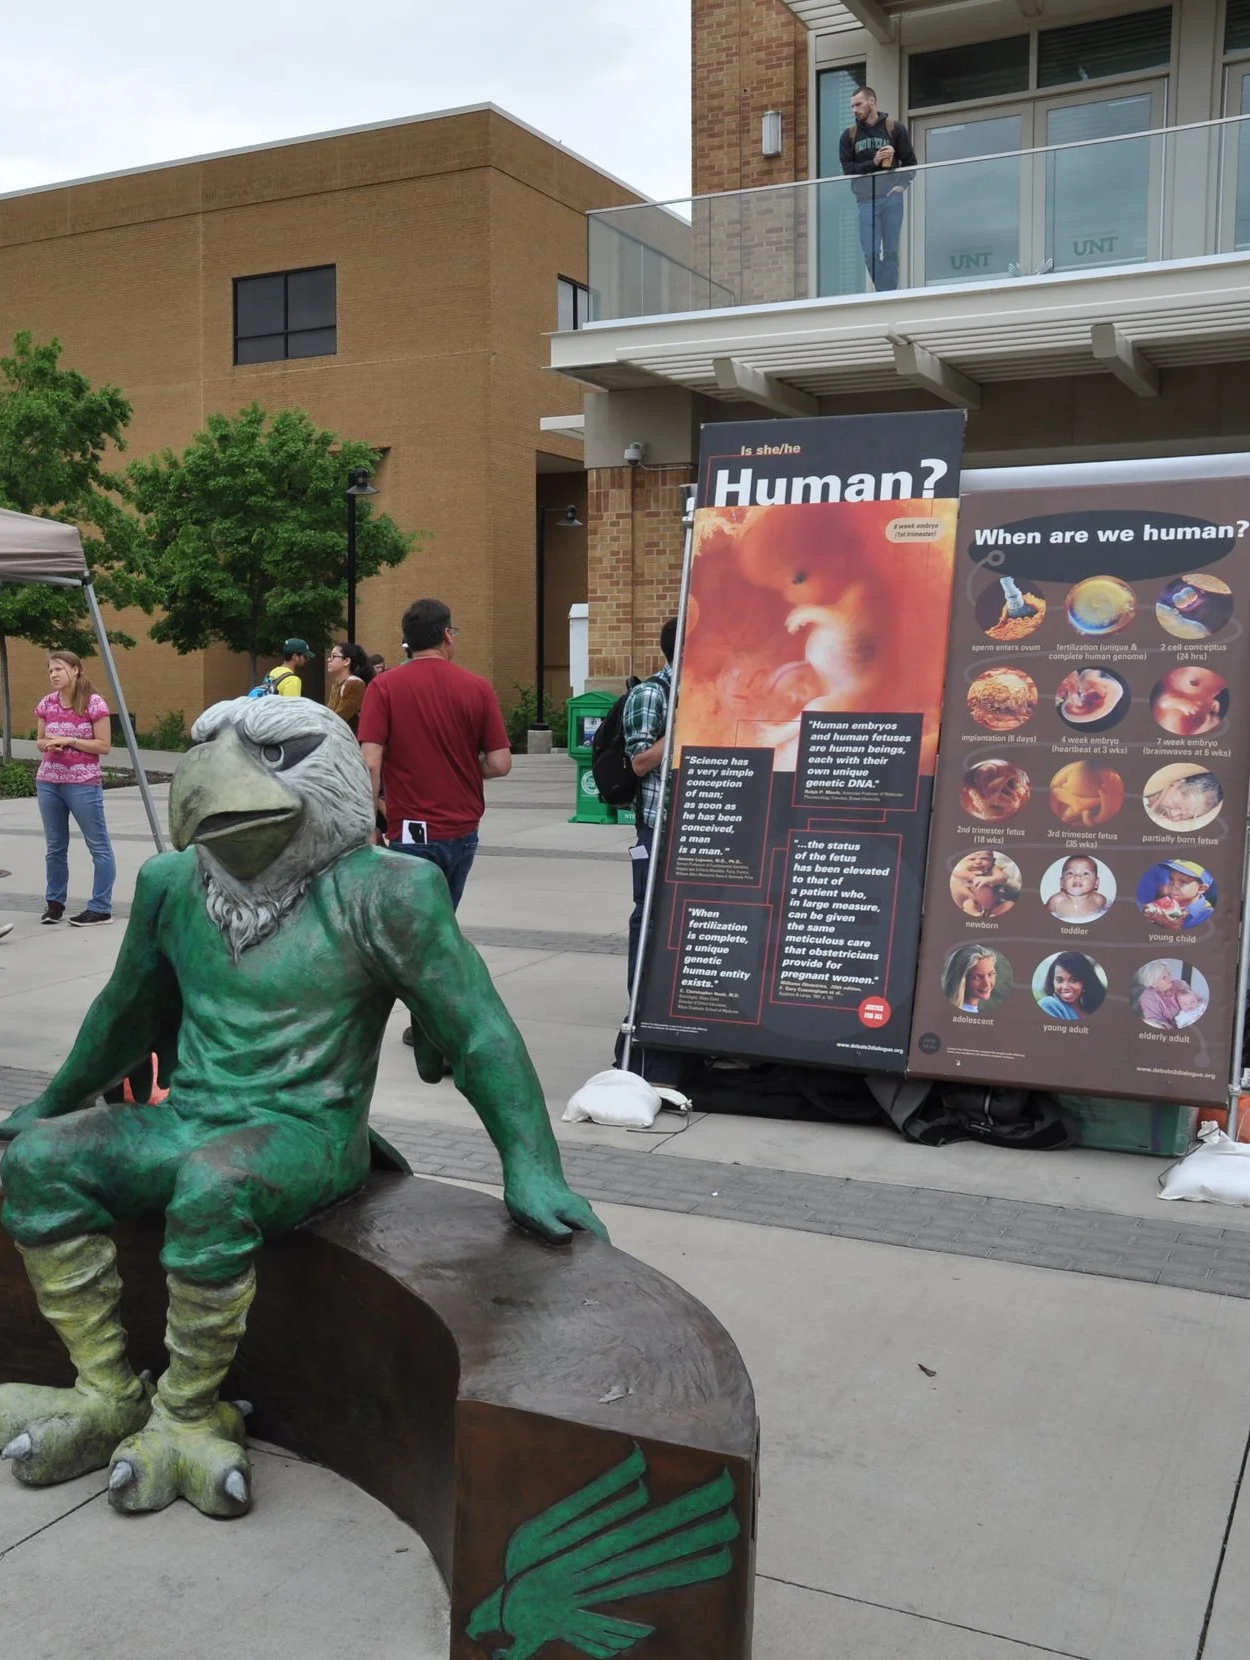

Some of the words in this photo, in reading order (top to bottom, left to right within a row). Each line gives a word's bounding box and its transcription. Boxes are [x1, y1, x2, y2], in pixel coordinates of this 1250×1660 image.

[1072, 236, 1118, 256] UNT
[950, 252, 994, 270] UNT
[740, 445, 752, 456] Is
[756, 443, 801, 456] she/he
[714, 458, 948, 507] Human?
[974, 528, 1041, 546] When
[1050, 528, 1088, 544] are
[1098, 527, 1134, 542] we
[1143, 520, 1250, 542] human?
[972, 644, 994, 652] sperm
[1100, 643, 1128, 652] (unique
[1184, 644, 1226, 652] conceptus
[1048, 652, 1084, 661] complete
[1085, 652, 1110, 660] human
[1112, 652, 1147, 661] genome)
[1176, 652, 1188, 660] (24
[1191, 652, 1207, 660] hrs)
[808, 720, 848, 730] "Human
[852, 722, 898, 732] embryos
[810, 732, 831, 740] and
[832, 732, 869, 742] human
[872, 733, 912, 742] fetuses
[962, 734, 1006, 742] implantation
[1016, 735, 1037, 744] days)
[1068, 736, 1088, 744] week
[1090, 737, 1119, 745] embryo
[1188, 740, 1218, 748] embryo
[809, 744, 826, 752] are
[828, 744, 865, 753] human
[867, 744, 906, 756] beings,
[1052, 745, 1092, 753] (heartbeat
[1108, 746, 1128, 754] wks)
[1142, 746, 1192, 756] (brainwaves
[1211, 749, 1231, 758] wks)
[684, 756, 728, 766] "Science
[730, 757, 749, 766] has
[808, 756, 832, 764] each
[836, 756, 860, 764] with
[863, 756, 890, 765] their
[696, 769, 718, 777] very
[720, 768, 754, 778] simple
[807, 768, 830, 776] own
[832, 768, 869, 778] unique
[686, 778, 742, 788] conception
[806, 779, 845, 788] genetic
[847, 779, 880, 788] DNA."
[685, 790, 697, 798] of
[698, 790, 724, 800] man;
[698, 802, 722, 810] soon
[682, 811, 695, 820] he
[698, 812, 716, 821] has
[718, 813, 742, 822] been
[681, 824, 734, 834] conceived,
[956, 826, 970, 834] 2nd
[972, 827, 1005, 835] trimester
[1006, 828, 1026, 836] fetus
[688, 836, 710, 844] man
[1048, 830, 1060, 838] 3rd
[1062, 830, 1096, 839] trimester
[1098, 832, 1118, 840] fetus
[1142, 834, 1174, 843] partially
[1176, 836, 1196, 844] born
[1198, 837, 1219, 845] fetus
[986, 836, 1004, 845] wks)
[1078, 840, 1098, 849] wks)
[678, 845, 688, 854] is
[827, 841, 860, 851] status
[794, 852, 808, 860] of
[810, 852, 826, 860] the
[829, 852, 857, 862] fetus
[793, 863, 812, 872] has
[814, 864, 840, 874] been
[843, 866, 890, 876] elevated
[806, 876, 828, 885] that
[830, 877, 844, 886] of
[800, 888, 838, 898] patient
[840, 890, 866, 900] who,
[790, 898, 800, 906] in
[802, 899, 830, 910] large
[832, 902, 881, 913] measure,
[688, 908, 720, 918] "When
[788, 911, 808, 919] can
[810, 912, 824, 920] be
[826, 912, 856, 922] given
[688, 920, 748, 932] fertilization
[786, 922, 804, 930] the
[807, 924, 836, 933] same
[966, 920, 998, 929] newborn
[1060, 926, 1089, 936] toddler
[687, 931, 696, 940] is
[698, 932, 748, 944] complete,
[785, 934, 844, 946] meticulous
[847, 939, 871, 948] care
[1148, 934, 1174, 942] young
[1176, 934, 1196, 943] child
[694, 944, 730, 954] unique
[784, 946, 807, 955] that
[809, 947, 880, 960] obstetricians
[684, 955, 722, 966] genetic
[782, 958, 824, 968] provide
[826, 960, 843, 970] for
[682, 966, 718, 976] human
[720, 970, 750, 981] entity
[780, 970, 830, 982] pregnant
[832, 974, 880, 985] women."
[681, 978, 718, 988] exists."
[952, 1016, 994, 1026] adolescent
[1043, 1024, 1067, 1034] young
[1069, 1026, 1089, 1034] adult
[1138, 1032, 1167, 1043] elderly
[1168, 1035, 1190, 1044] adult
